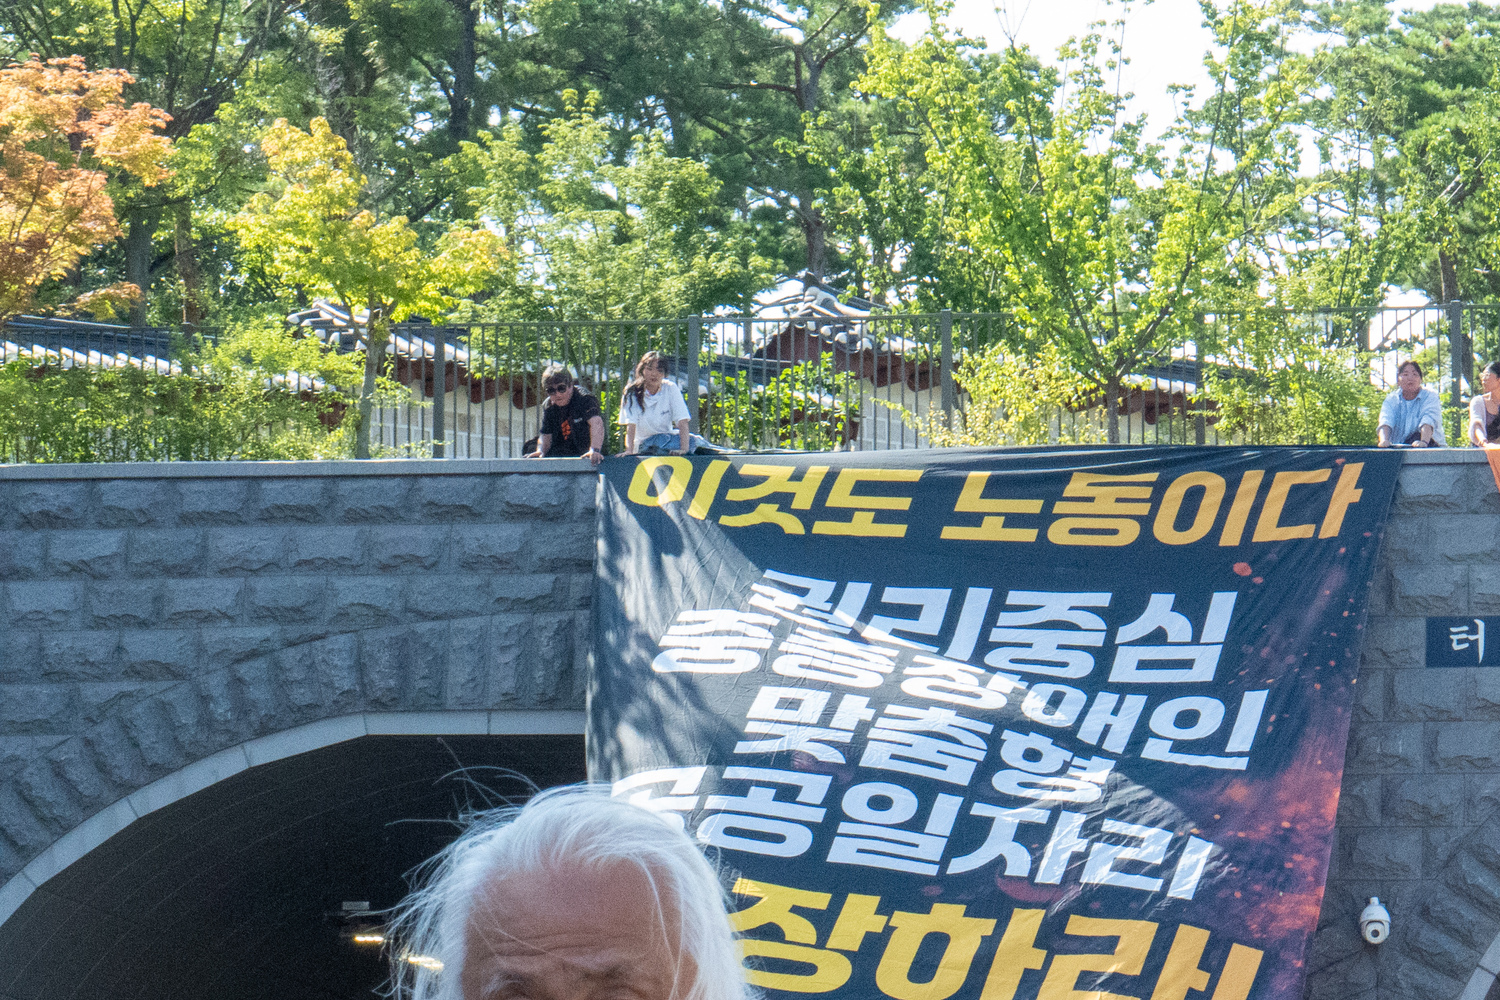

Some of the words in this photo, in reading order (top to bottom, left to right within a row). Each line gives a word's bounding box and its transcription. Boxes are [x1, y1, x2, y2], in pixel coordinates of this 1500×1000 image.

[627, 455, 925, 538] 이것도
[940, 460, 1364, 547] 노동이다
[748, 568, 1238, 684] 권리중심
[651, 608, 1269, 770] 중증장애인
[732, 685, 1118, 803] 맞춤형
